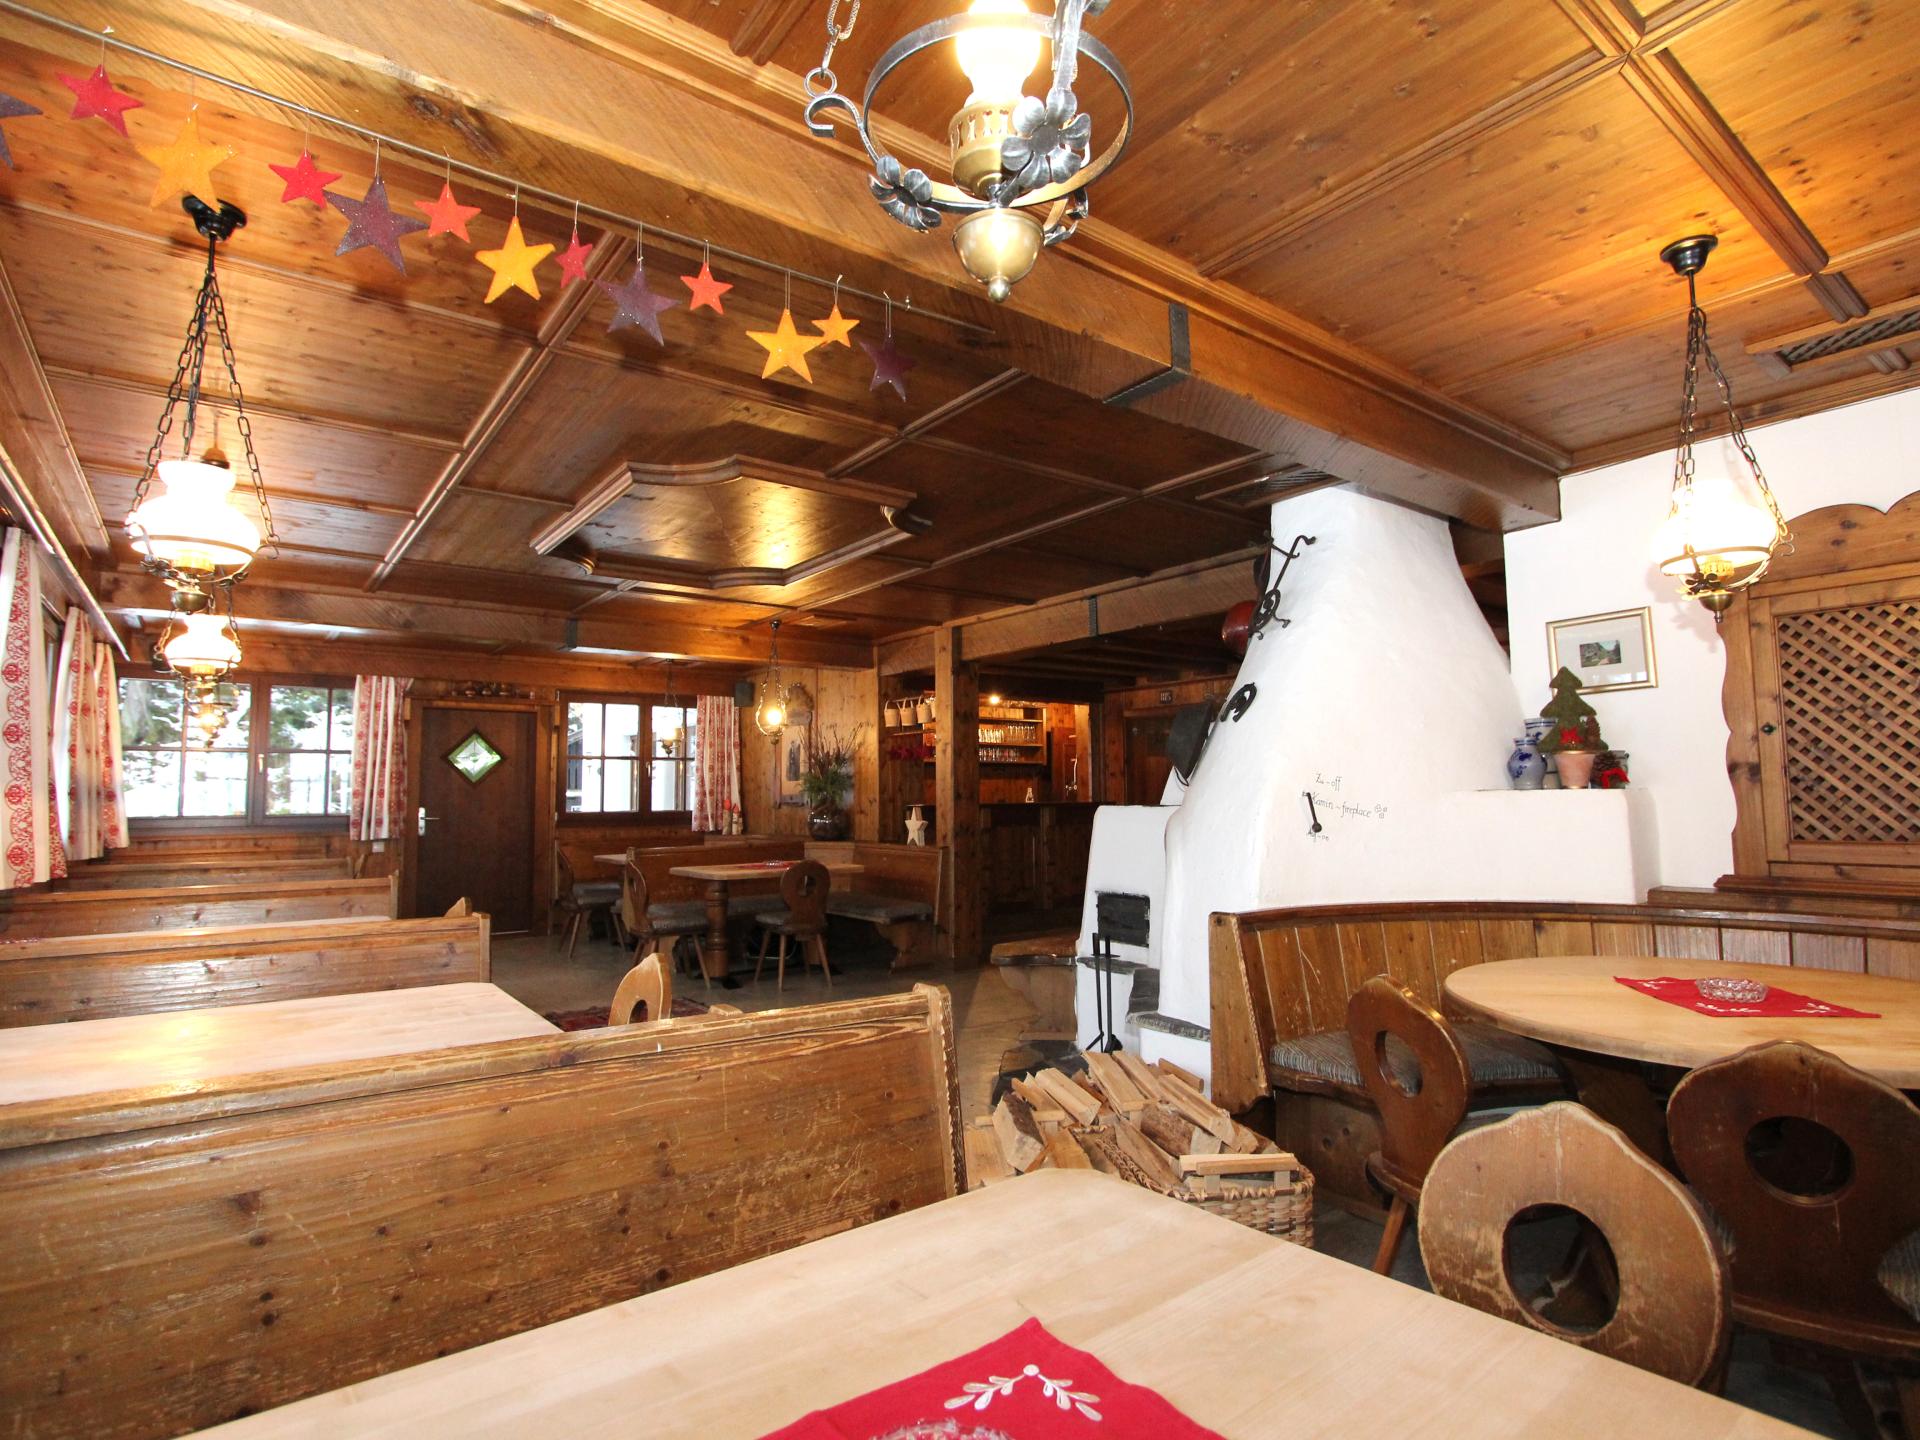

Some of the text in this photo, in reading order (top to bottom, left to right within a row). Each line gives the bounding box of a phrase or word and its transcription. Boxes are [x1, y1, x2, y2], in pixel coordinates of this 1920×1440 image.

[1331, 776, 1342, 792] off
[1312, 792, 1334, 810] Kamin
[1340, 801, 1372, 819] fireplace
